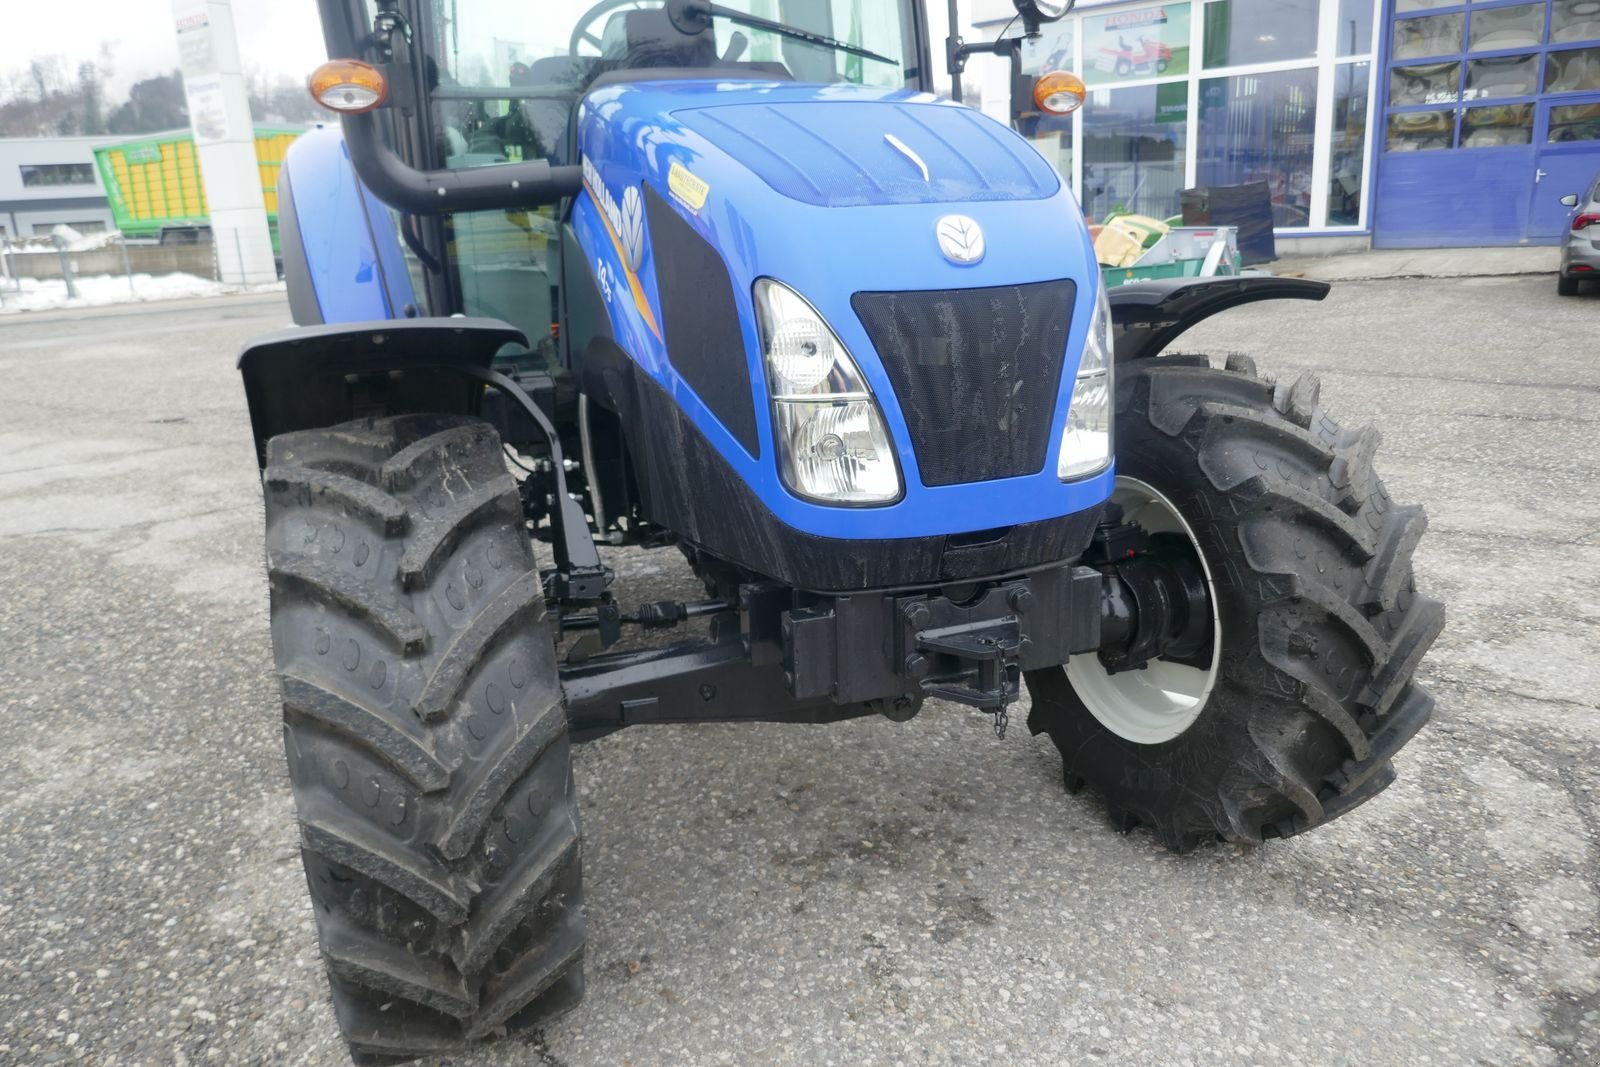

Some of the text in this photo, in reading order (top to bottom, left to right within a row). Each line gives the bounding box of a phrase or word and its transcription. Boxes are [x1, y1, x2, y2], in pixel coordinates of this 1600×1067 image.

[176, 13, 208, 29] HONDA
[1104, 9, 1166, 26] HONDA
[592, 166, 622, 237] HOLLAND
